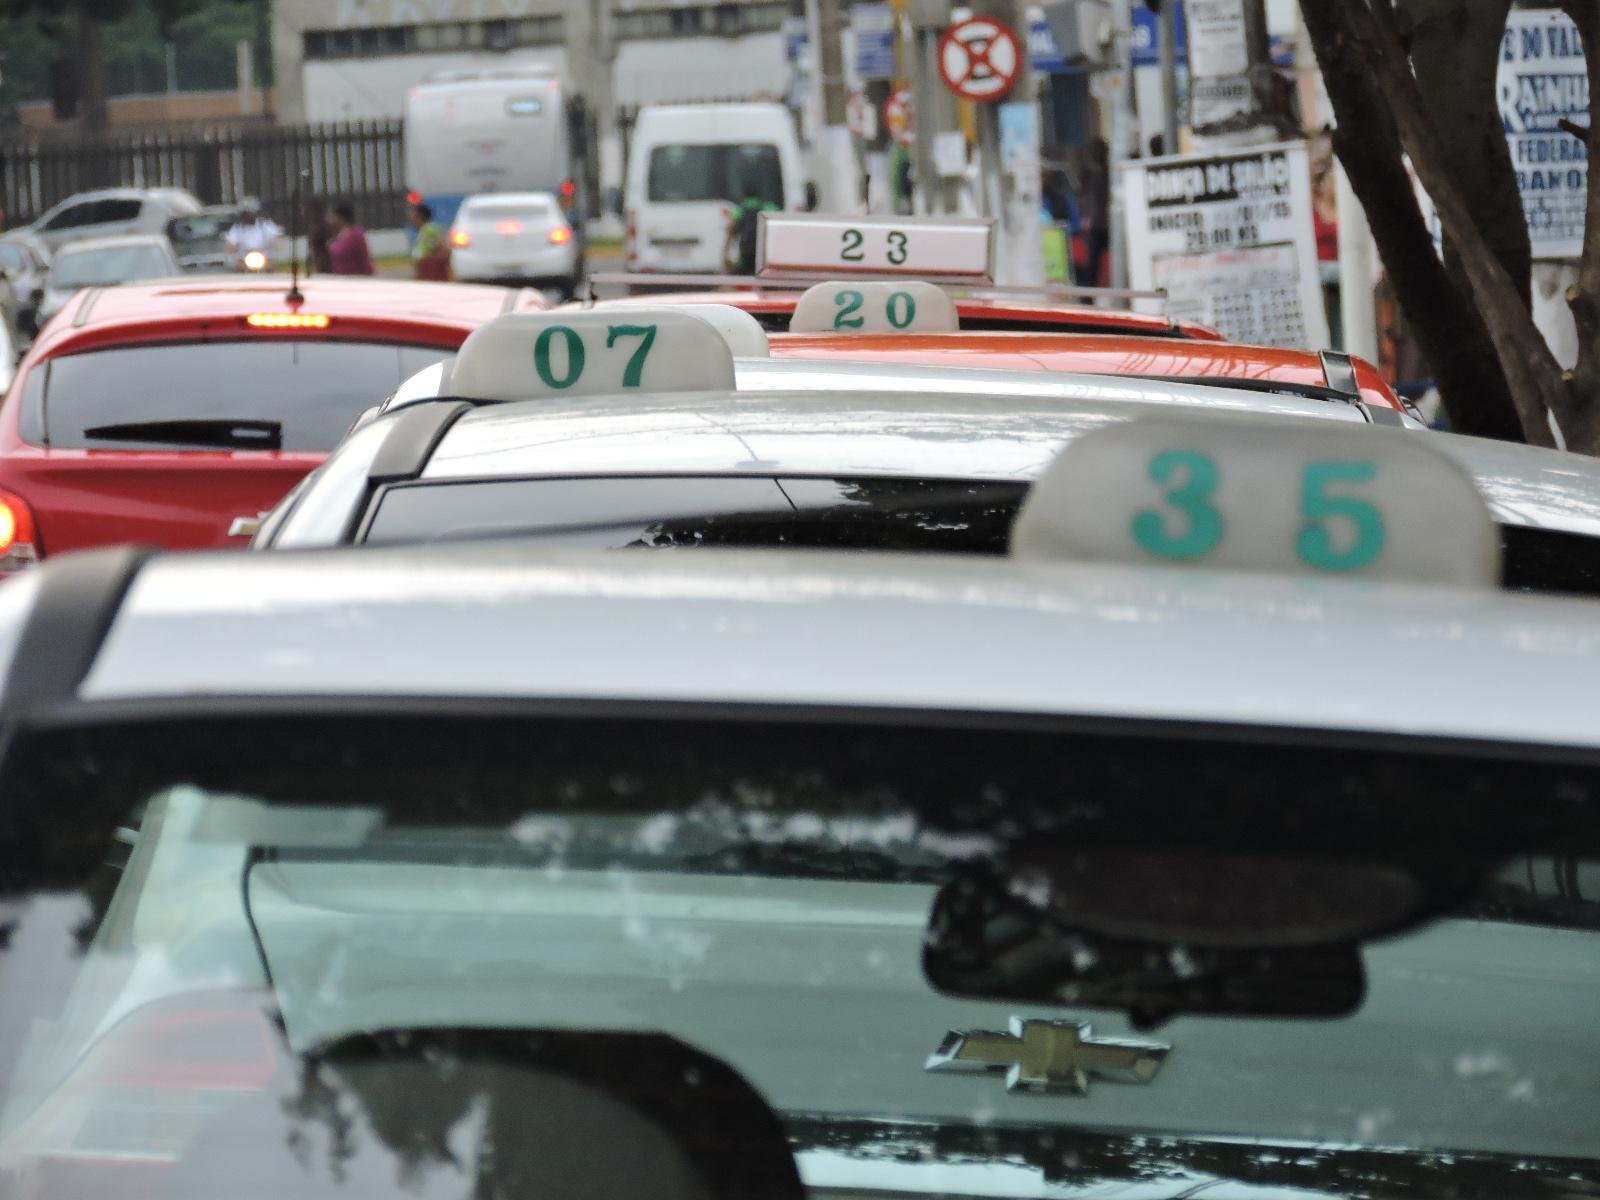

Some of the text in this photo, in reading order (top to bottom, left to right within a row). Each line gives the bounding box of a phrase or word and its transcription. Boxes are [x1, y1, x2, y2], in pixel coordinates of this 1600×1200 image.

[841, 230, 909, 264] 23
[834, 291, 917, 330] 20
[534, 324, 659, 391] 07
[1131, 448, 1386, 573] 35
